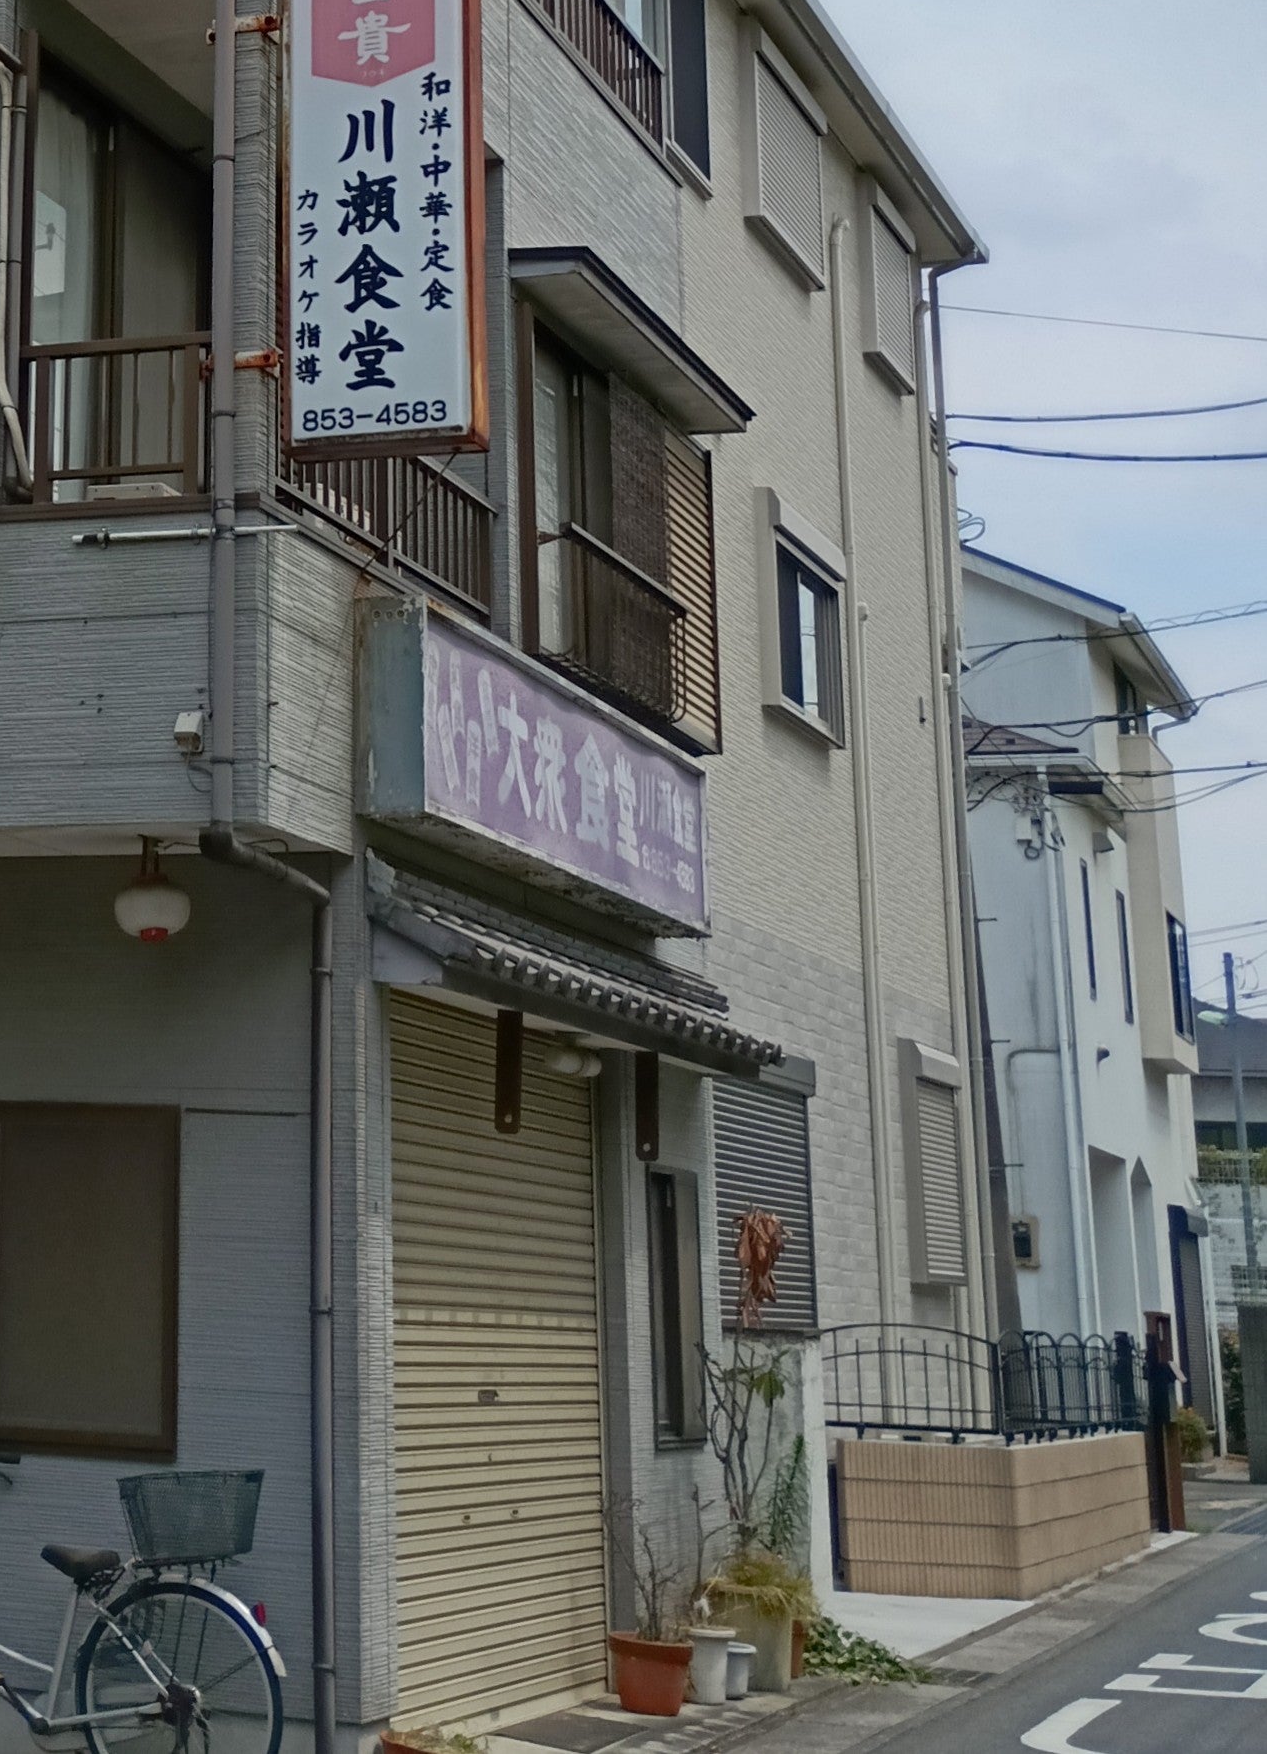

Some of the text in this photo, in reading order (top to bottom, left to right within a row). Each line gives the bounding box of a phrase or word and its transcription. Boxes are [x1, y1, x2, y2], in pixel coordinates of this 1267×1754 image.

[294, 189, 322, 385] カラオケ指導
[334, 98, 405, 391] 川瀬食堂
[302, 400, 448, 432] 853-4583
[497, 692, 640, 868] 大衆食堂
